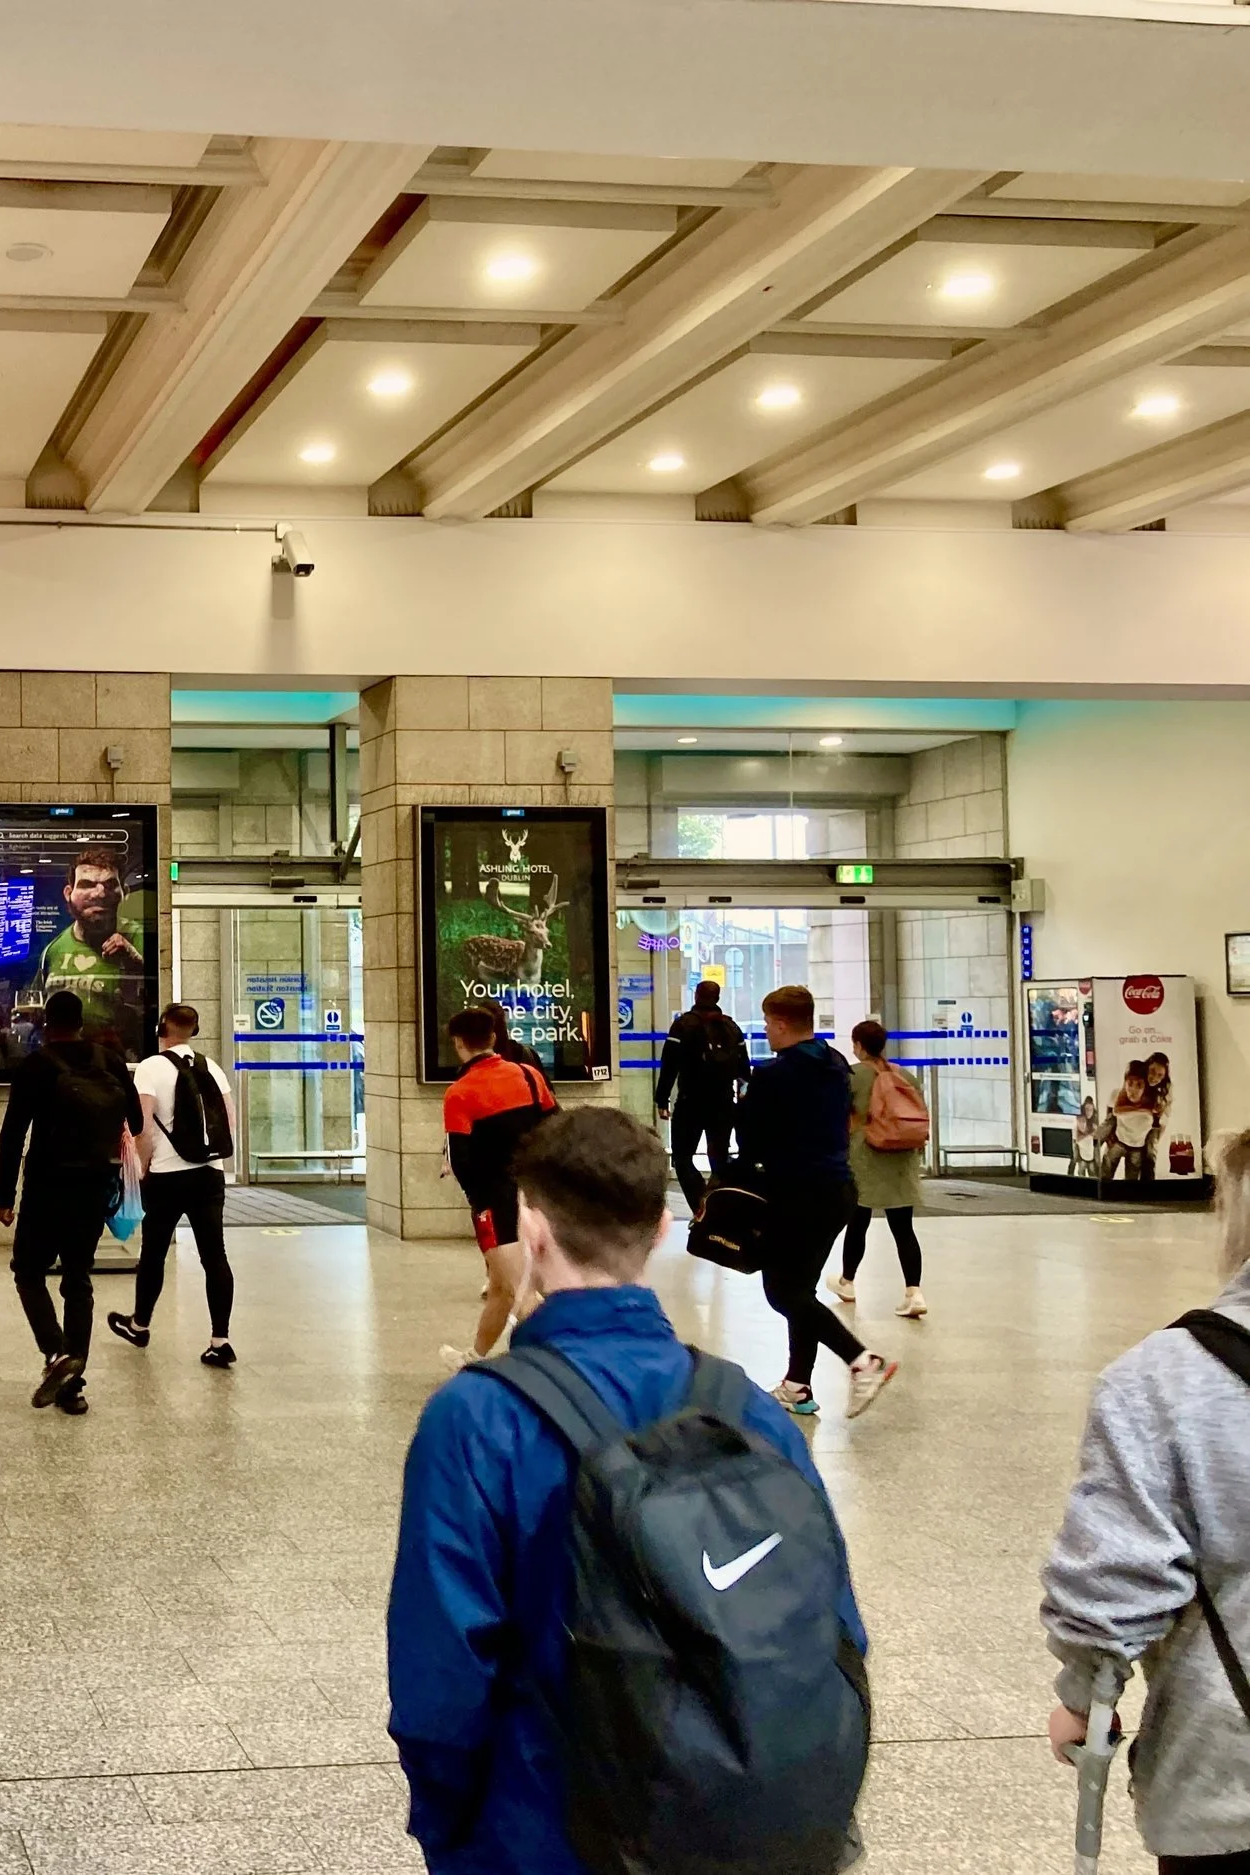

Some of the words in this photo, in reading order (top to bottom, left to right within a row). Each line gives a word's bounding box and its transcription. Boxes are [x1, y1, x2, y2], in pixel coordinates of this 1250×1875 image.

[479, 864, 519, 873] ASHLING
[523, 865, 552, 873] HOTEL
[60, 953, 73, 970] I
[460, 979, 509, 998] Your
[516, 978, 575, 999] hotel,
[533, 1000, 573, 1024] city,
[531, 1022, 583, 1046] park.
[1128, 1025, 1141, 1034] Go
[1119, 1036, 1140, 1045] grab
[1150, 1035, 1172, 1043] Coke
[594, 1068, 607, 1076] 1712
